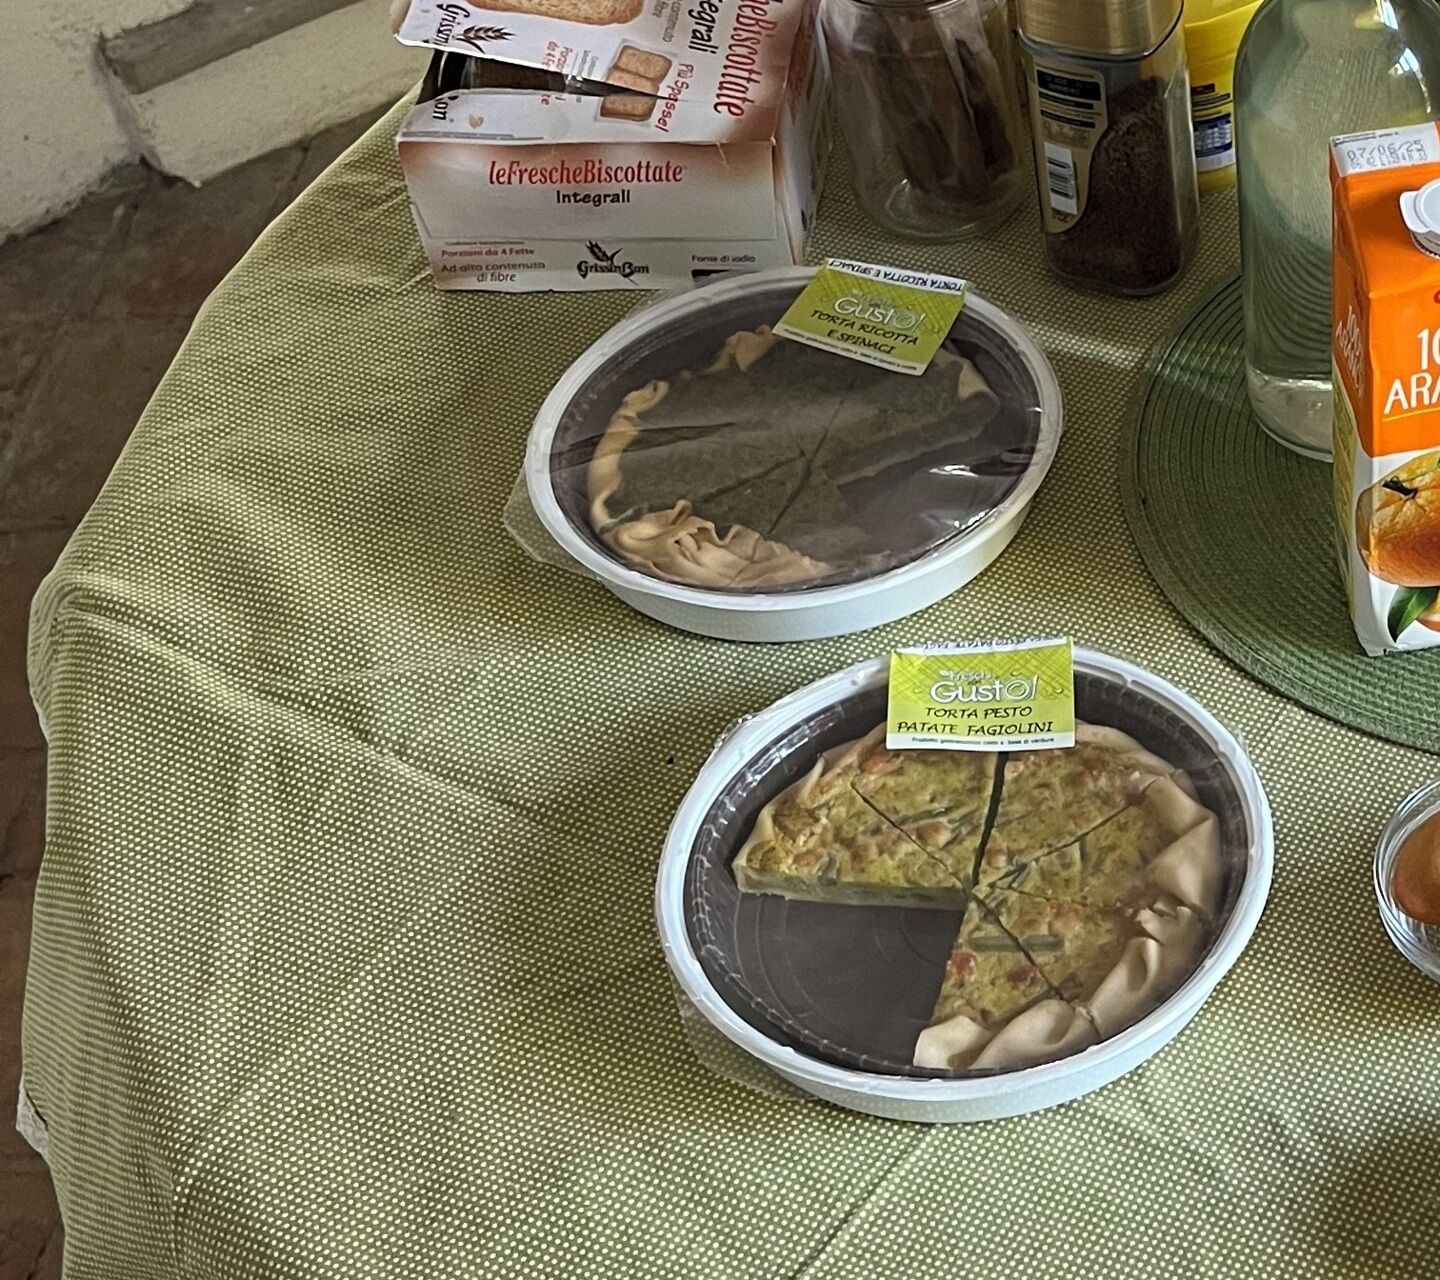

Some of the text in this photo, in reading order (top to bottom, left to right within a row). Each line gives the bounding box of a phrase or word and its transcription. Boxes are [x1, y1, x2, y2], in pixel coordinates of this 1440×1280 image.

[488, 158, 684, 186] leFrescheBiscottate
[555, 189, 632, 207] Integrali
[509, 247, 535, 256] Fette
[441, 261, 546, 273] Ad alto contenuto
[476, 271, 517, 283] di fibre
[883, 270, 928, 288] RICOTTA
[929, 278, 965, 293] TORTA
[810, 308, 920, 346] TORTA RICOTTA
[826, 328, 897, 355] E SPINACI
[924, 705, 1033, 719] TORTA PESTO
[897, 720, 1054, 737] PATATE FAGIOLINI
